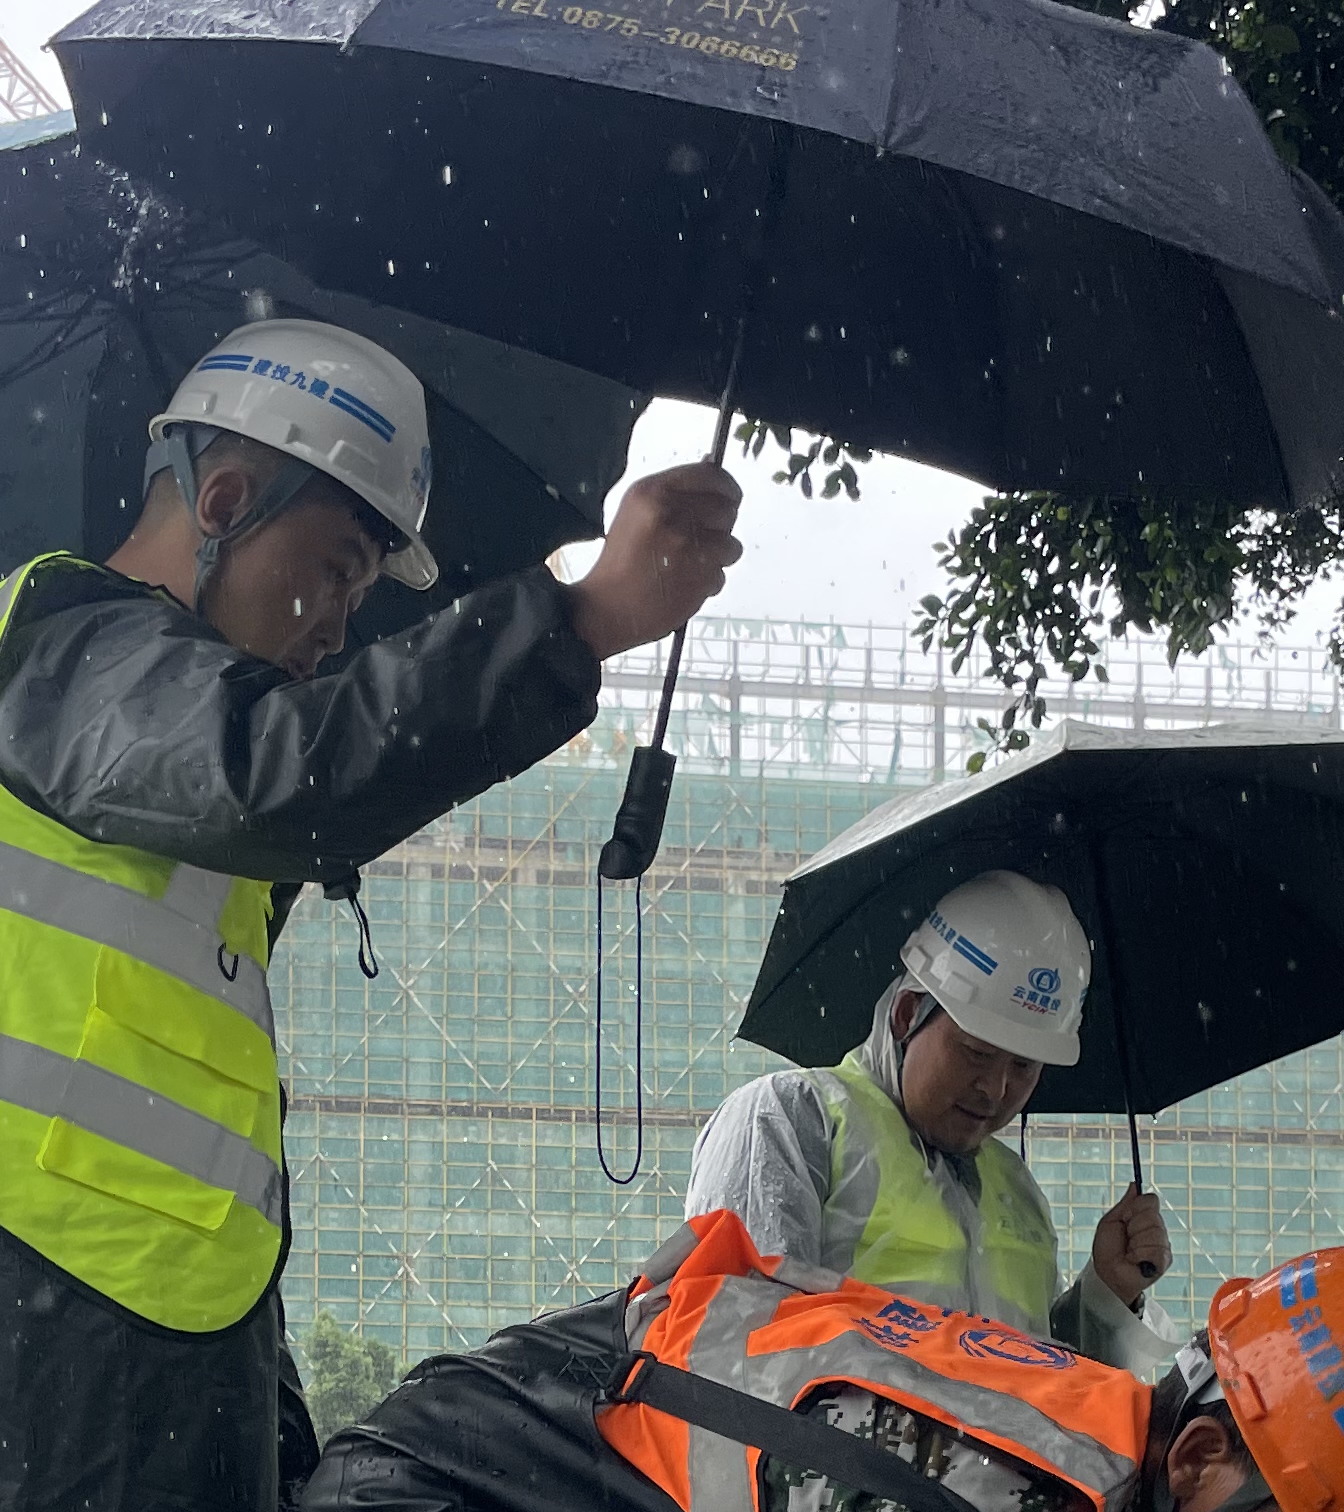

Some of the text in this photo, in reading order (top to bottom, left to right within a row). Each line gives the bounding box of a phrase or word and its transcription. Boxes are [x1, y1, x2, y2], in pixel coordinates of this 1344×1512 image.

[252, 359, 330, 400] 建投九建
[1013, 985, 1061, 1012] 云南建投
